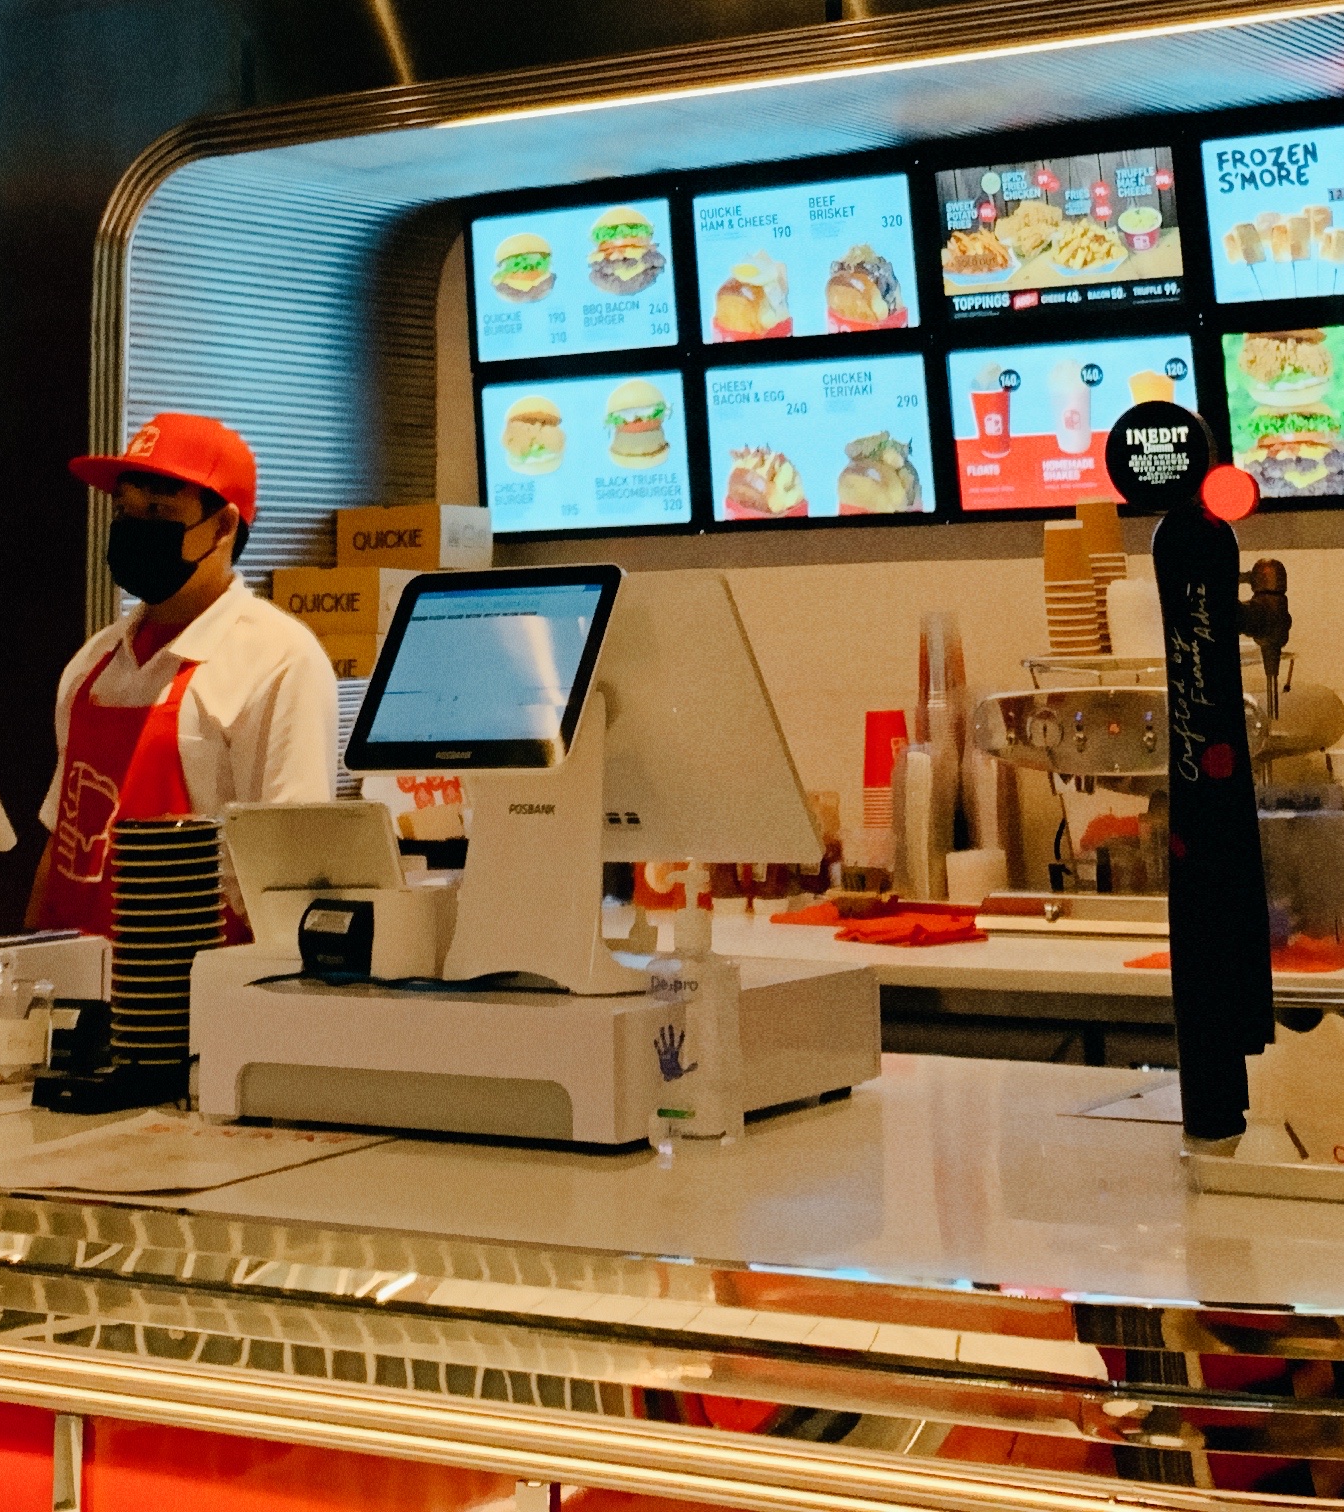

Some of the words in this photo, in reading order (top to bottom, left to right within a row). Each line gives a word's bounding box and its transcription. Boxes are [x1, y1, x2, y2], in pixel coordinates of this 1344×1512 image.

[1216, 141, 1318, 172] FROZEN
[1218, 165, 1310, 193] S'MORE
[809, 195, 836, 208] BEEF
[700, 205, 742, 219] QUICKIE
[809, 206, 855, 220] BRISKET
[700, 219, 724, 231] HAM
[728, 218, 734, 229] &
[737, 214, 778, 228] CHEESE
[882, 215, 903, 227] 320
[773, 226, 791, 238] 190
[952, 292, 1010, 311] TOPPINGS
[583, 314, 625, 327] BURGER
[651, 323, 670, 335] 360
[823, 372, 872, 385] CHICKEN
[712, 380, 753, 393] CHEESY
[823, 384, 873, 398] TERIYAKI
[713, 392, 750, 405] BACON
[763, 390, 785, 402] EGG
[896, 395, 918, 408] 290
[787, 403, 807, 415] 240
[1125, 425, 1189, 445] INEDIT
[632, 473, 677, 485] TRUFFLE
[353, 529, 423, 551] QUICKIE
[288, 592, 360, 614] QUICKIE
